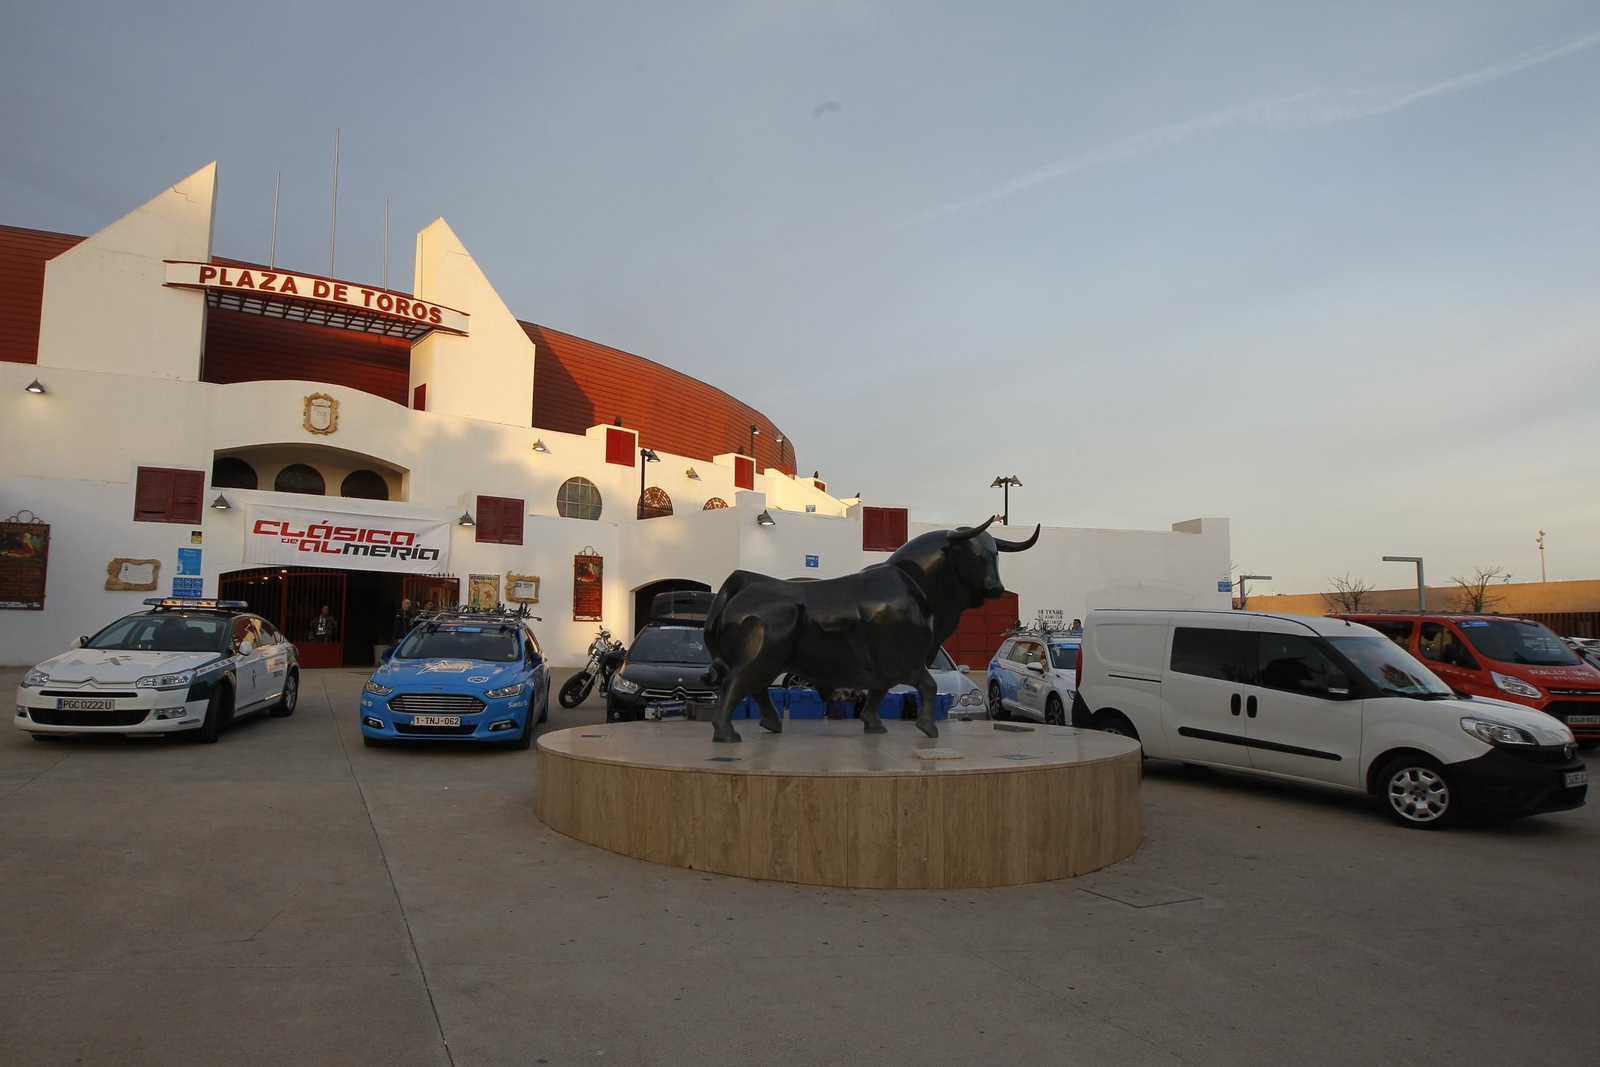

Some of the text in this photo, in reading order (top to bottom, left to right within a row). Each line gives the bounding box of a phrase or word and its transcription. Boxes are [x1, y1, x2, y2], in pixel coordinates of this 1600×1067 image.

[199, 266, 443, 324] PLAZA DE TOROS
[253, 520, 416, 546] CLÁSICA
[63, 700, 111, 709] PGC 0222 U
